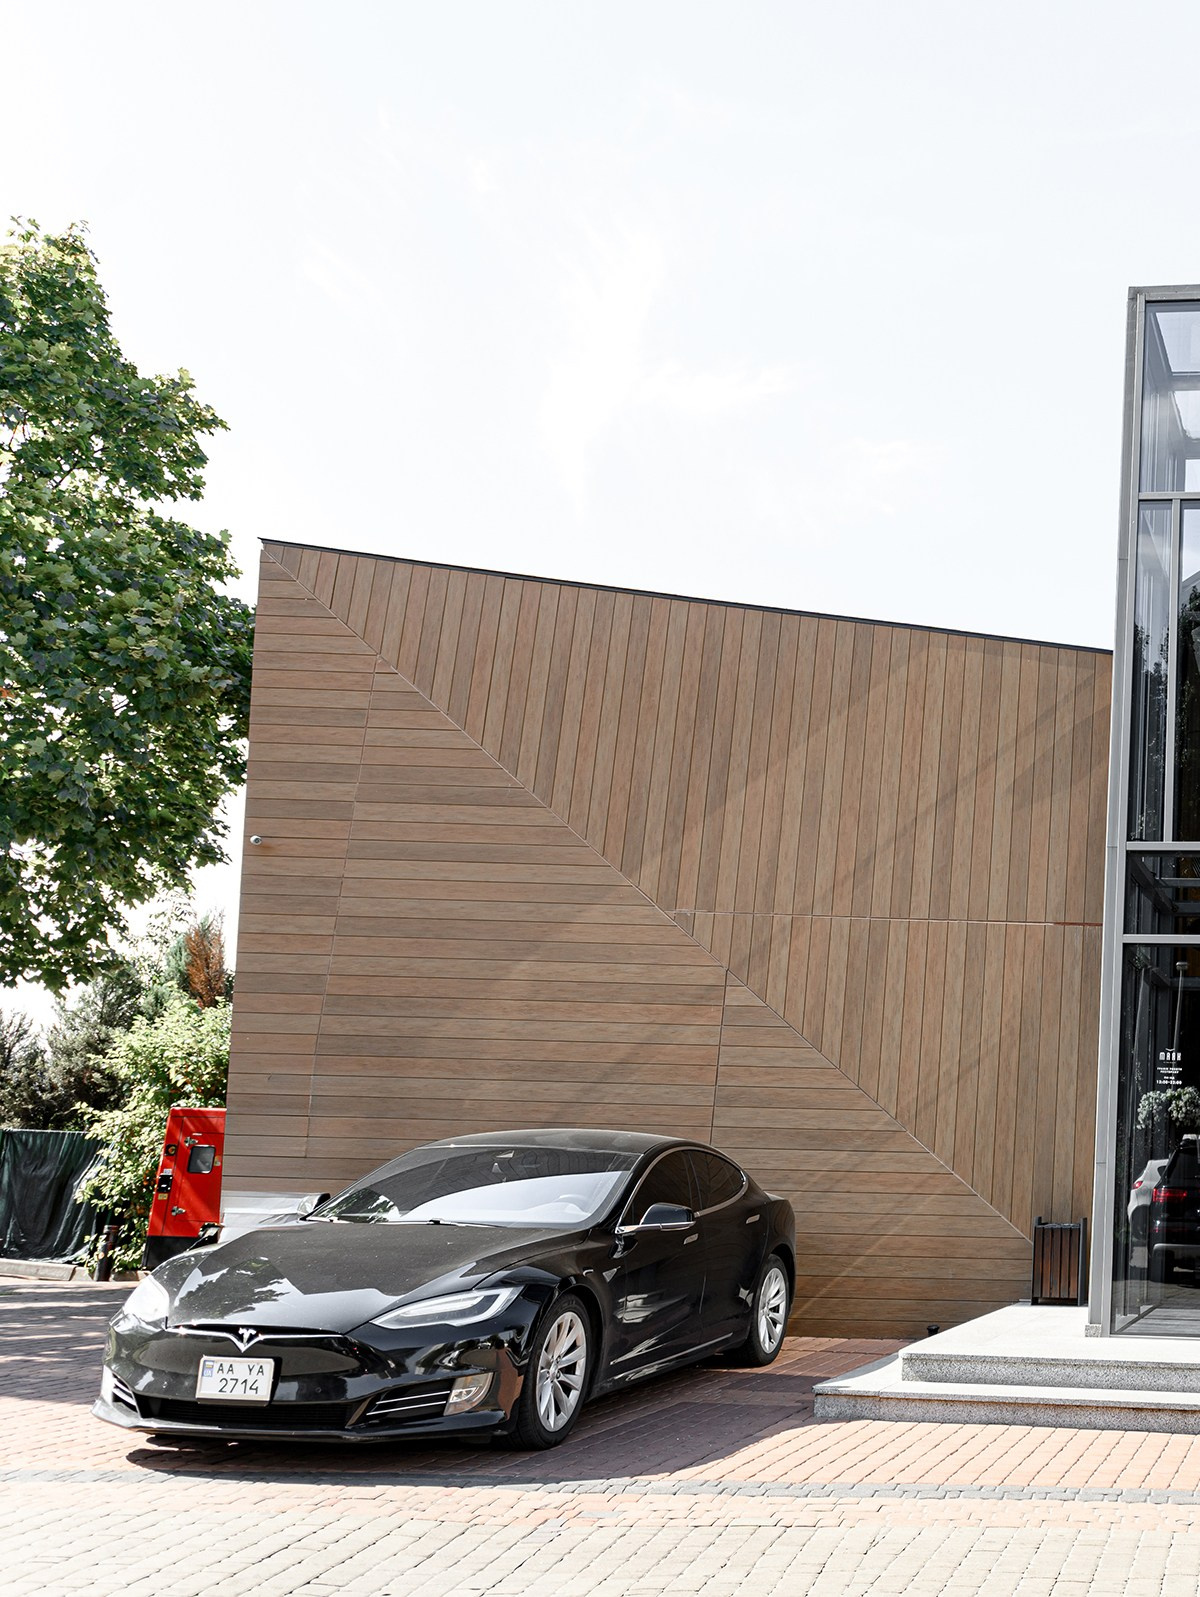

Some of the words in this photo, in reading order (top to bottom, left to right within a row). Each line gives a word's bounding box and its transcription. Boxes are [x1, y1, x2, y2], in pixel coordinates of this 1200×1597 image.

[217, 1363, 234, 1375] AA
[247, 1364, 264, 1376] YA
[218, 1377, 259, 1395] 2714
